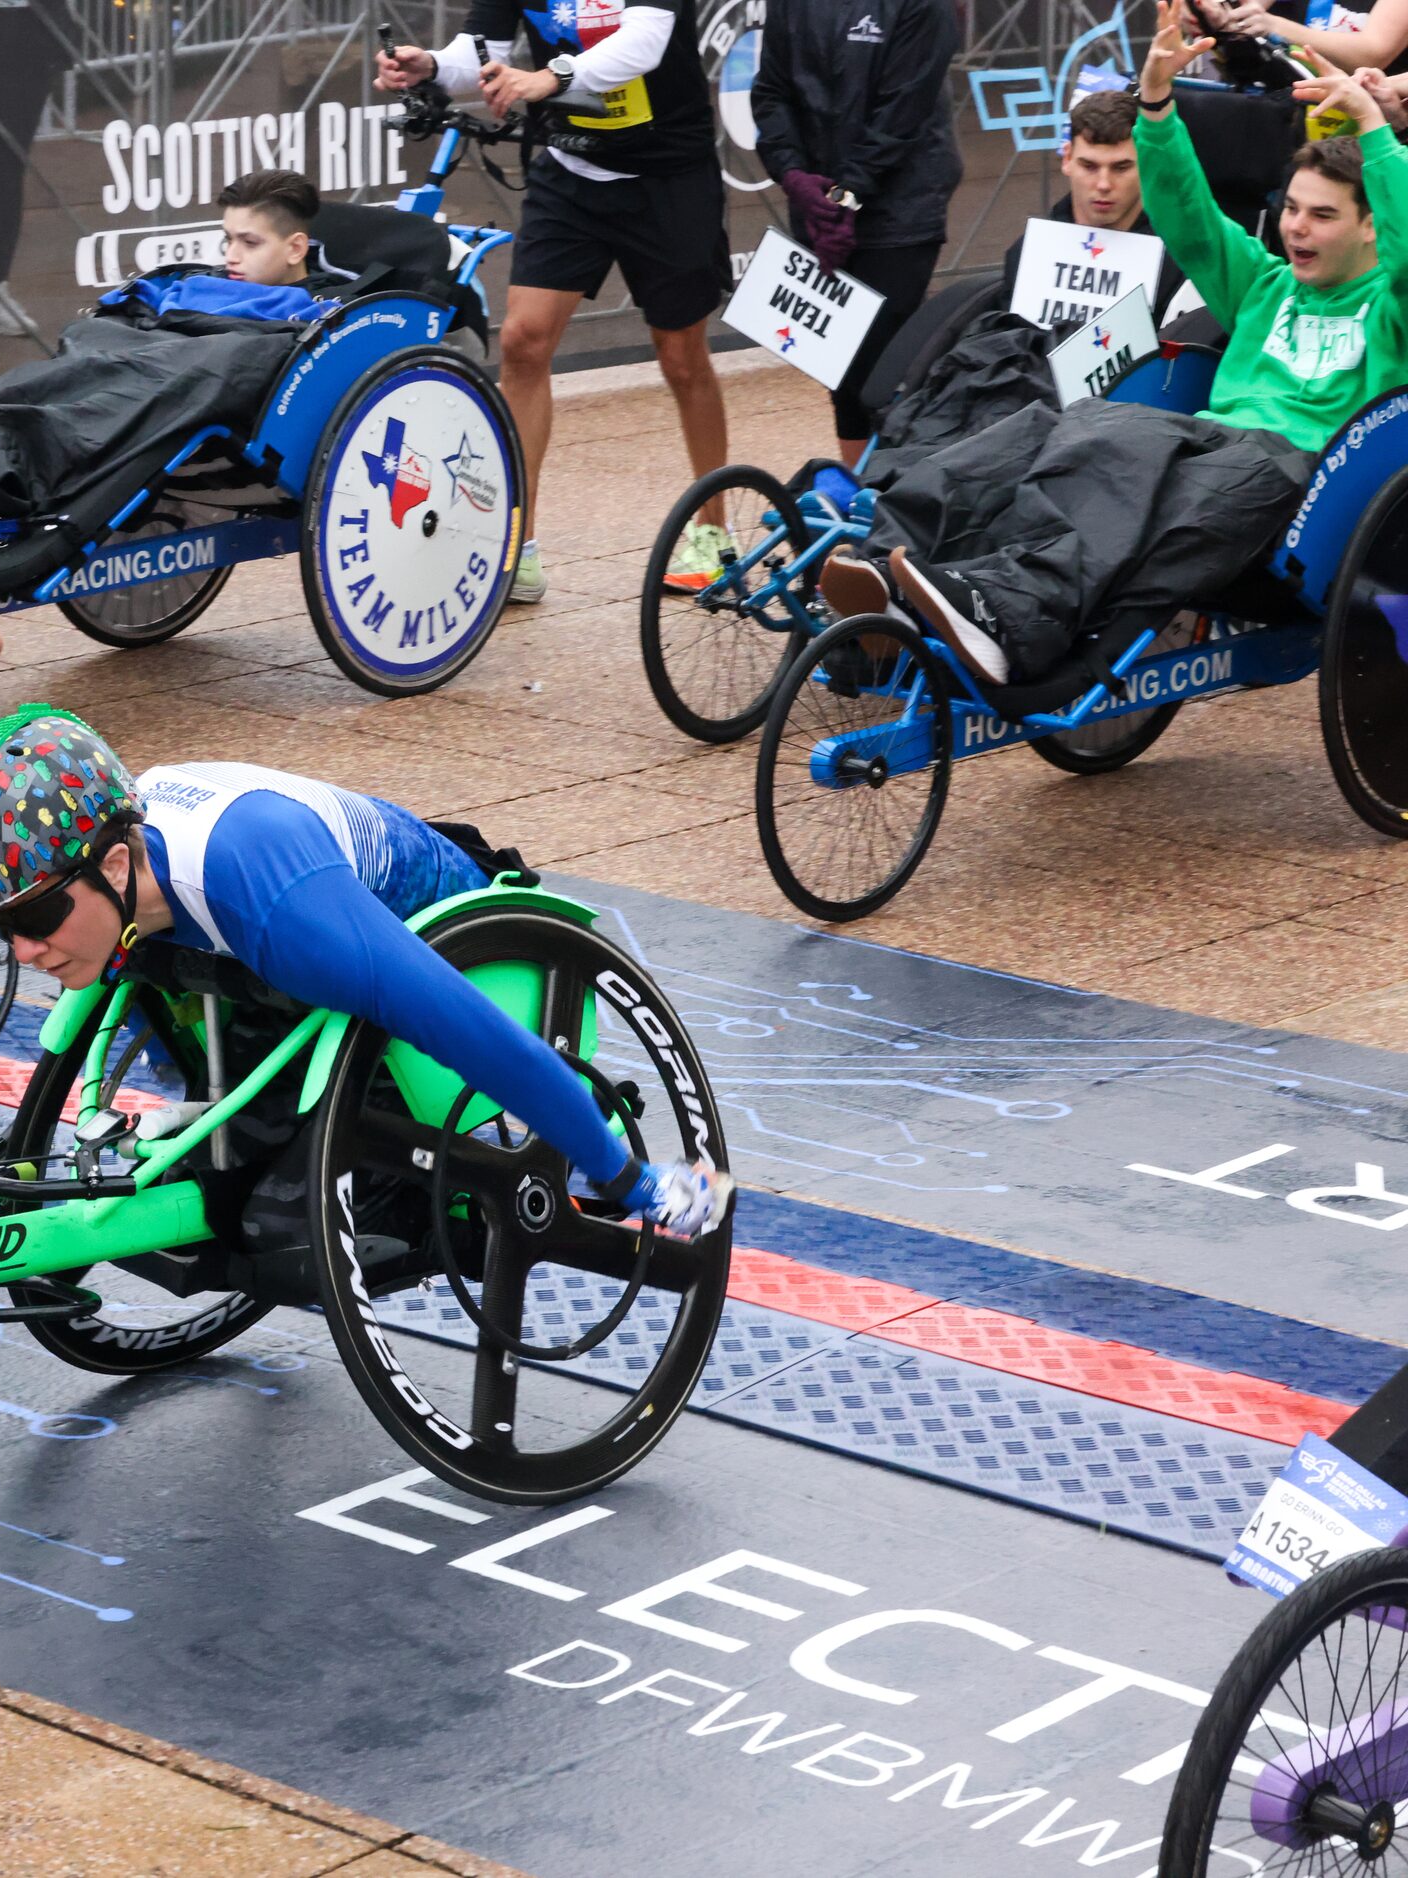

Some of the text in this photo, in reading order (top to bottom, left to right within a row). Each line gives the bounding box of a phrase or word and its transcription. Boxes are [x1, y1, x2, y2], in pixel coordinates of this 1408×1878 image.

[102, 101, 407, 214] SCOTTISH RITE
[157, 240, 202, 263] FOR
[1054, 262, 1121, 297] TEAM
[426, 311, 440, 340] 5
[769, 284, 832, 339] TEAM
[1038, 299, 1104, 326] JAM
[1084, 343, 1134, 397] TEAM
[339, 508, 396, 634] TEAM
[398, 551, 489, 648] MILES
[149, 781, 217, 803] GAMES
[595, 969, 719, 1238] CORIM
[336, 1170, 476, 1452] CORIMA
[1246, 1511, 1265, 1539] A
[1240, 1556, 1297, 1596] MARATHO
[505, 1638, 1264, 1878] DFWBMW
